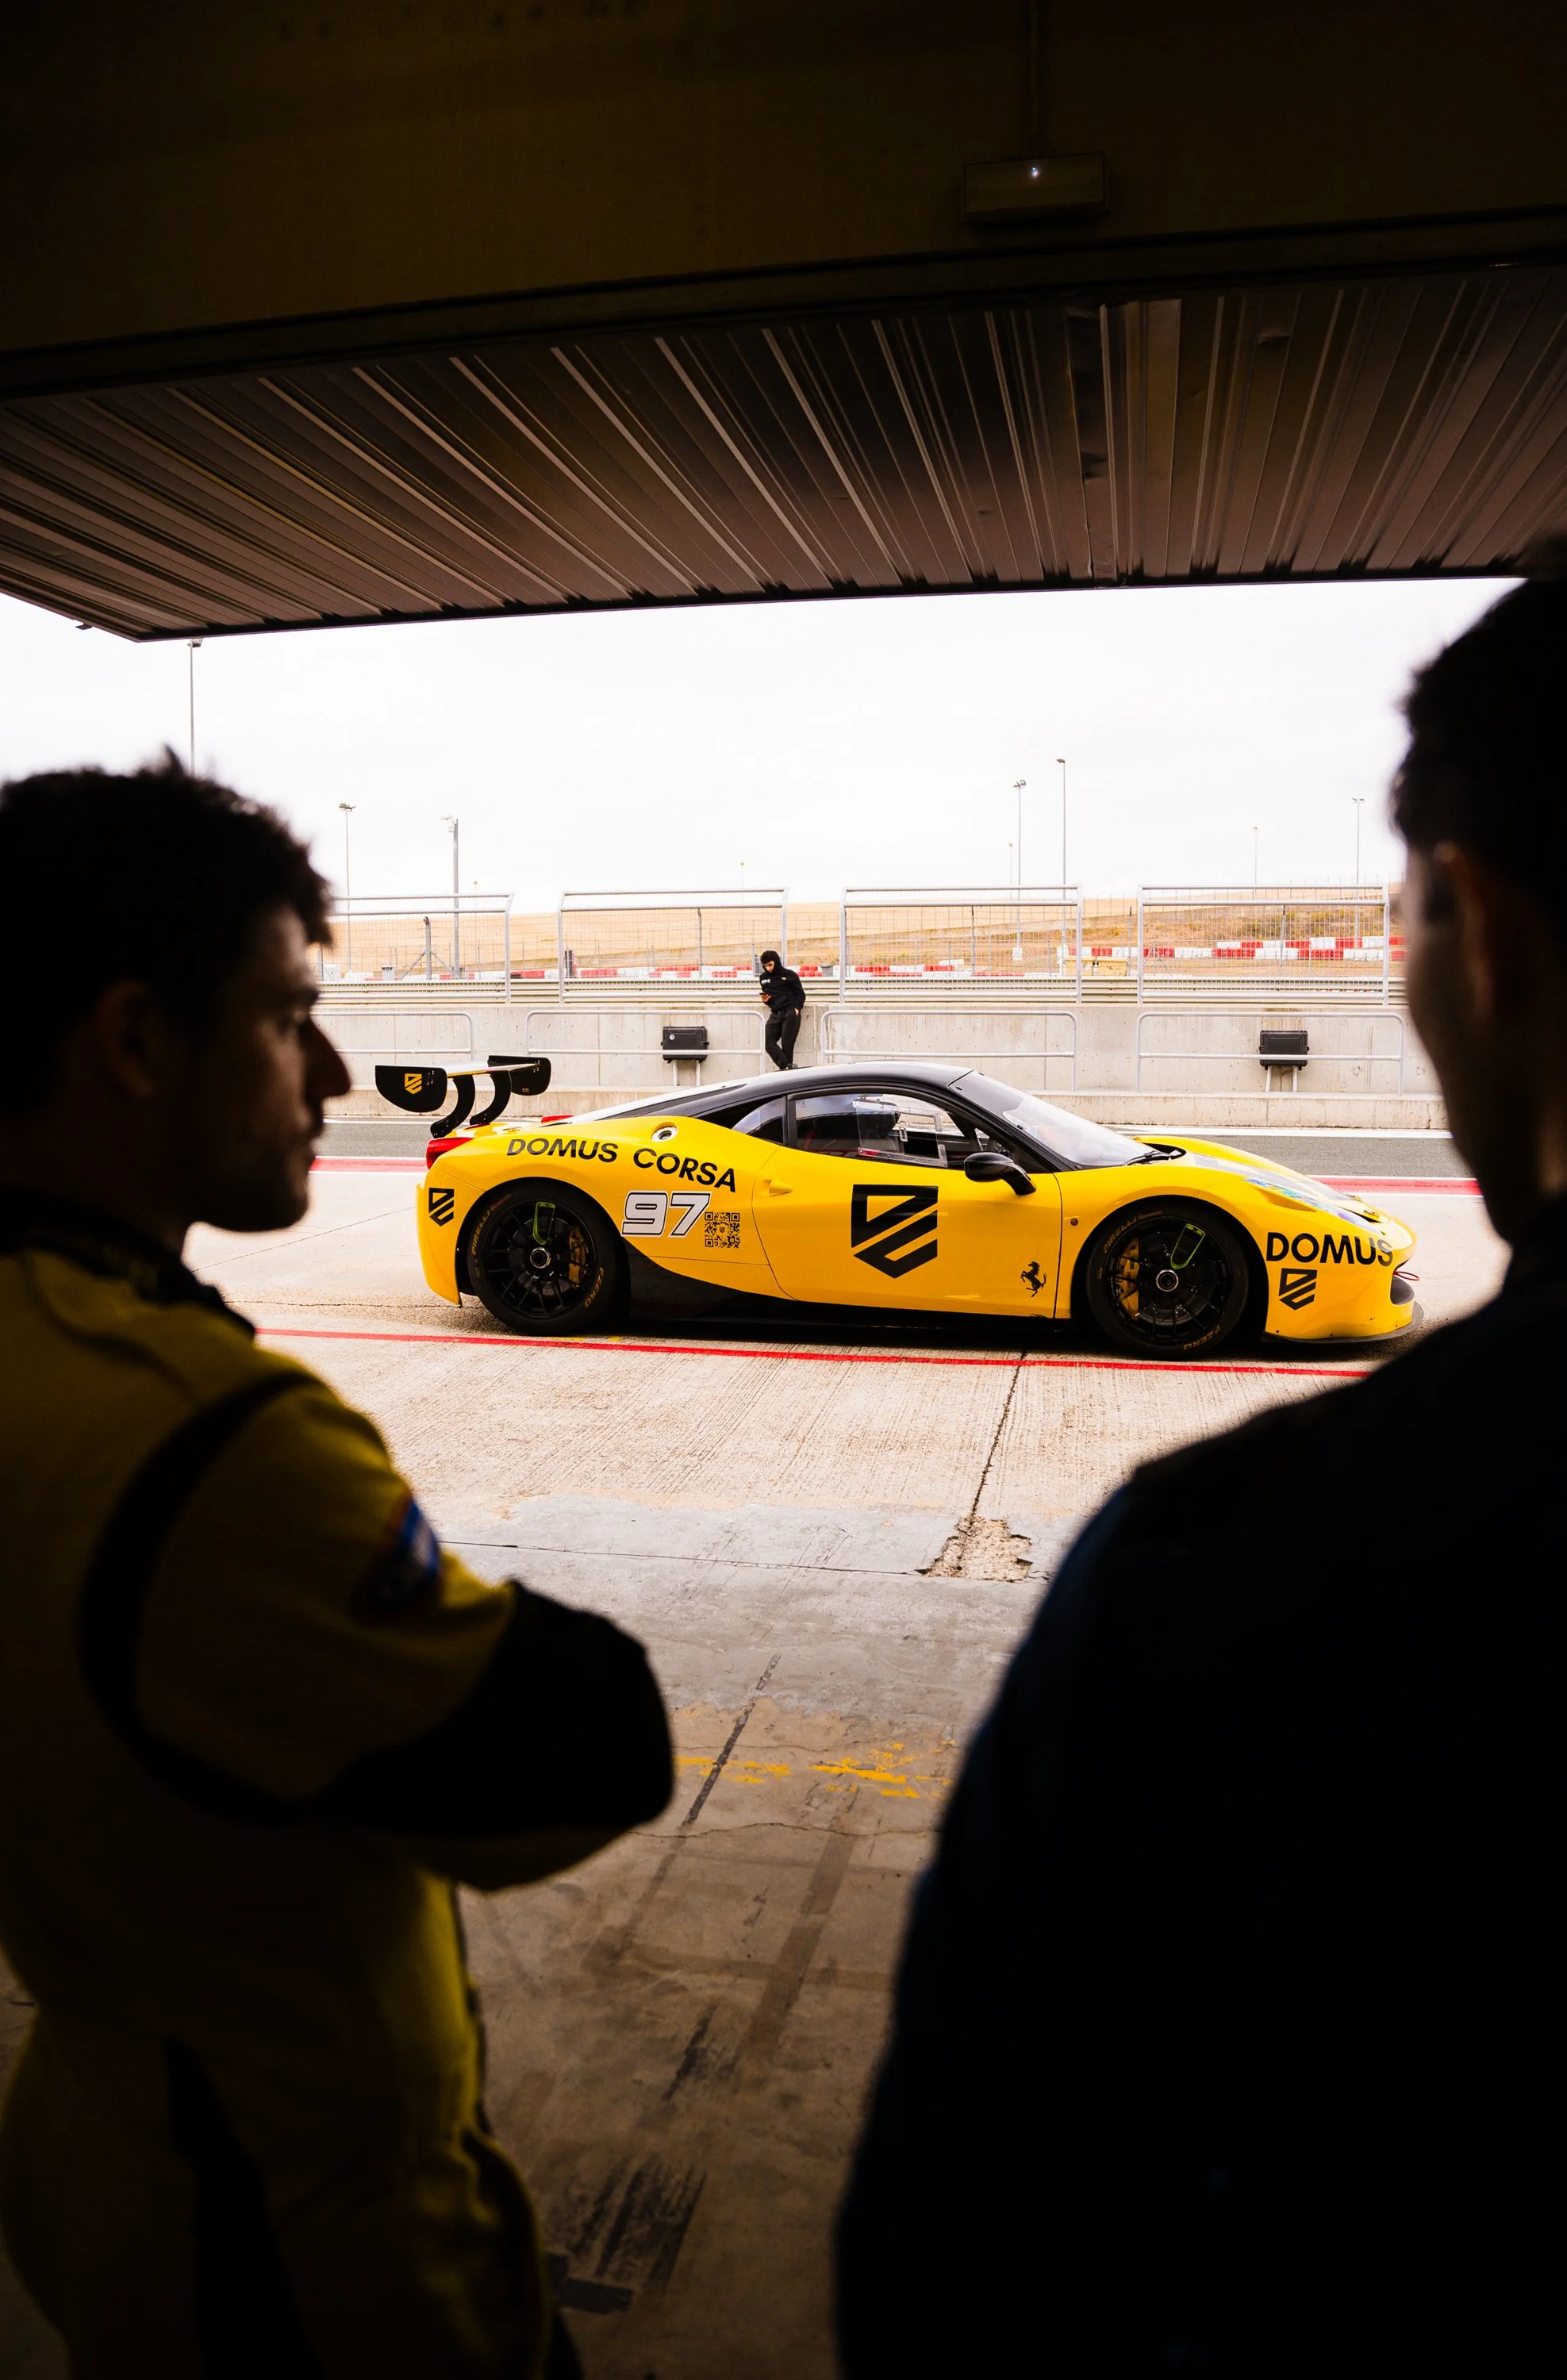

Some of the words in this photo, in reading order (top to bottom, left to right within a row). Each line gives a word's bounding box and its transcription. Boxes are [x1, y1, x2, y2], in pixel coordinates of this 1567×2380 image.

[506, 1138, 618, 1163] DOMUS
[633, 1148, 735, 1192] CORSA
[471, 1209, 491, 1256] PIRELLI
[620, 1190, 712, 1238] 97
[1266, 1231, 1393, 1267] DOMUS
